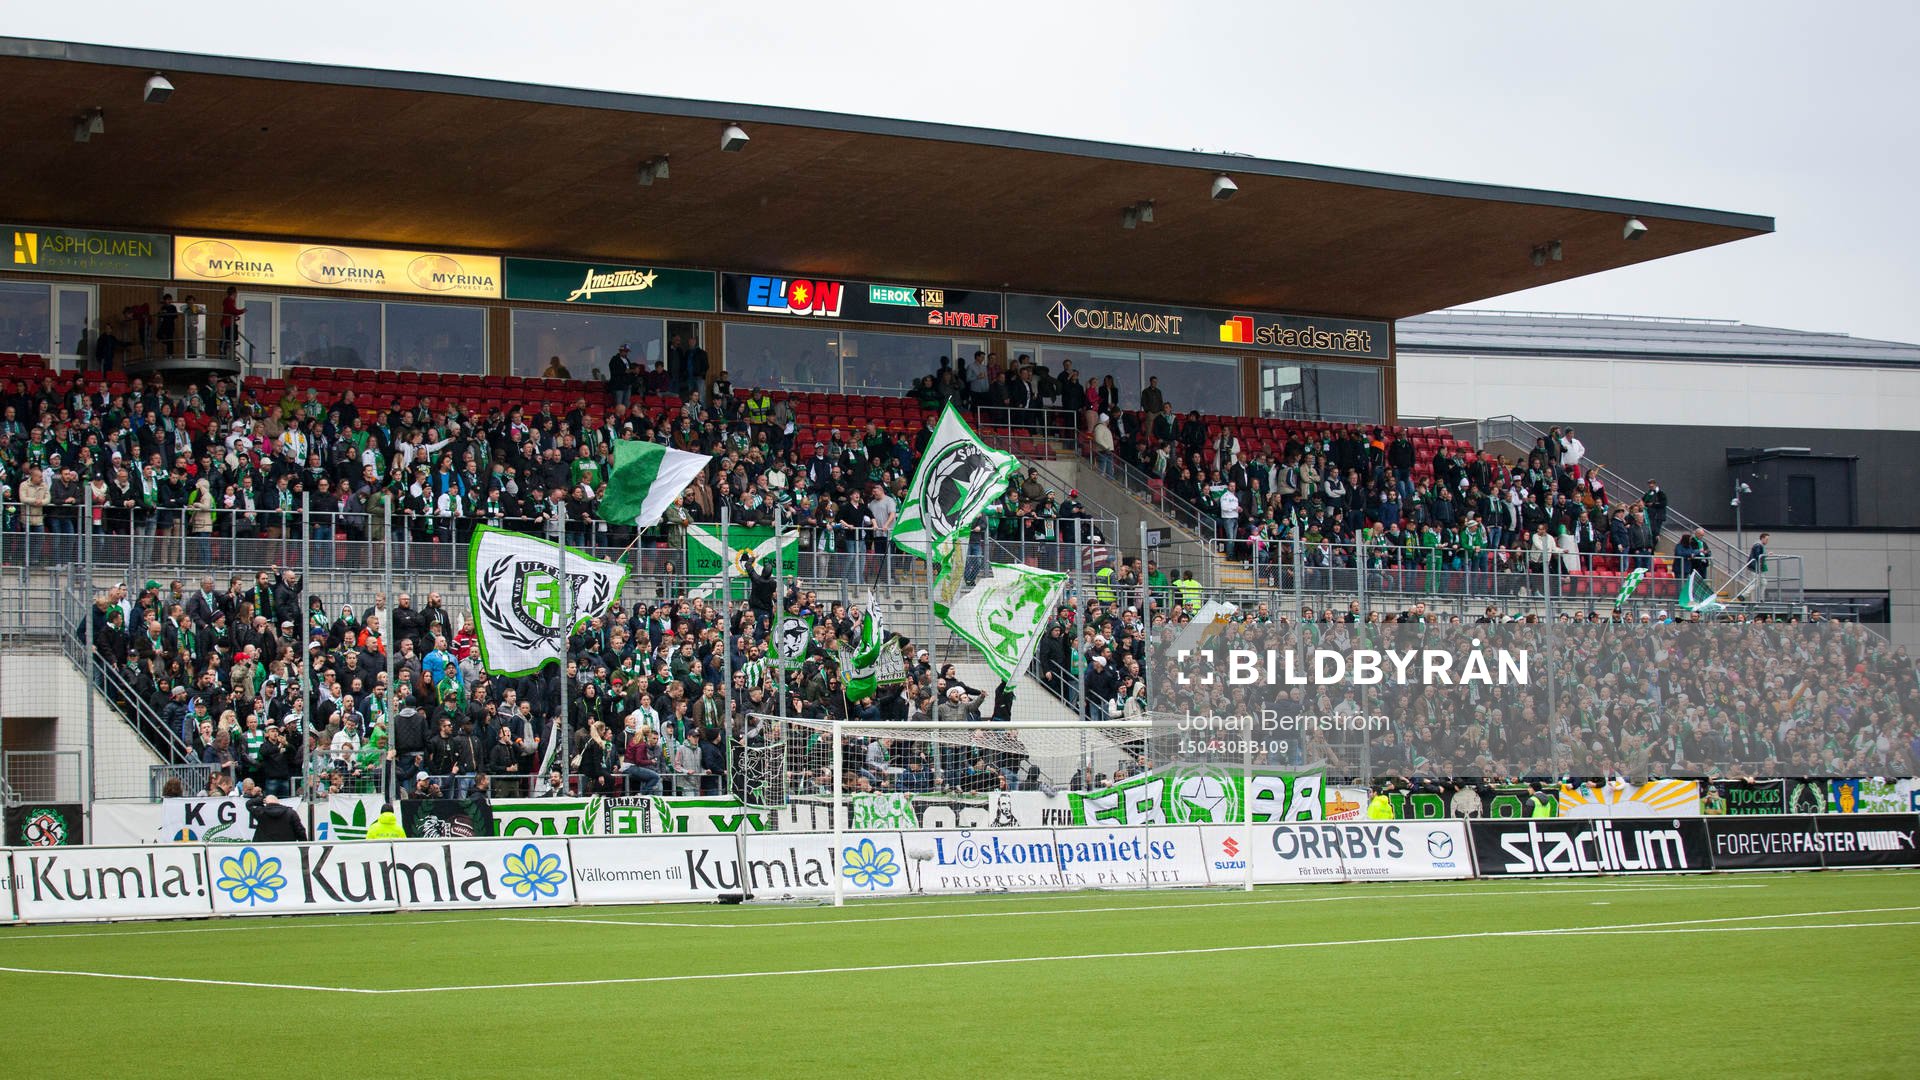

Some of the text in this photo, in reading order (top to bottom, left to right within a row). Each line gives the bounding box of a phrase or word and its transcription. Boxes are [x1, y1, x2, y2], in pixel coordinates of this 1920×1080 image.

[42, 235, 153, 257] ASPHOLMEN
[208, 259, 274, 273] MYRINA
[321, 265, 385, 280] MYRINA
[431, 272, 494, 287] MYRINA
[747, 276, 845, 318] ELON
[872, 288, 943, 304] HEROK XL
[944, 311, 999, 329] HYRLIFT
[1073, 308, 1183, 336] COLEMONT
[1256, 323, 1372, 352] stadsnät
[607, 797, 649, 808] ULTRAS
[1729, 788, 1781, 806] TJOCKIS
[1272, 825, 1404, 860] ORRBYS
[1500, 820, 1689, 873] stadium
[1856, 830, 1900, 851] PUMA
[29, 852, 206, 902] Kumla!
[297, 844, 497, 903] Kumla
[576, 866, 661, 882] Välkommen
[666, 865, 682, 880] till
[941, 868, 1181, 888] PRISPRESSAREN PÅ NÄTET
[1298, 866, 1311, 876] För
[1312, 866, 1334, 875] livets
[1353, 866, 1389, 875] äventurer
